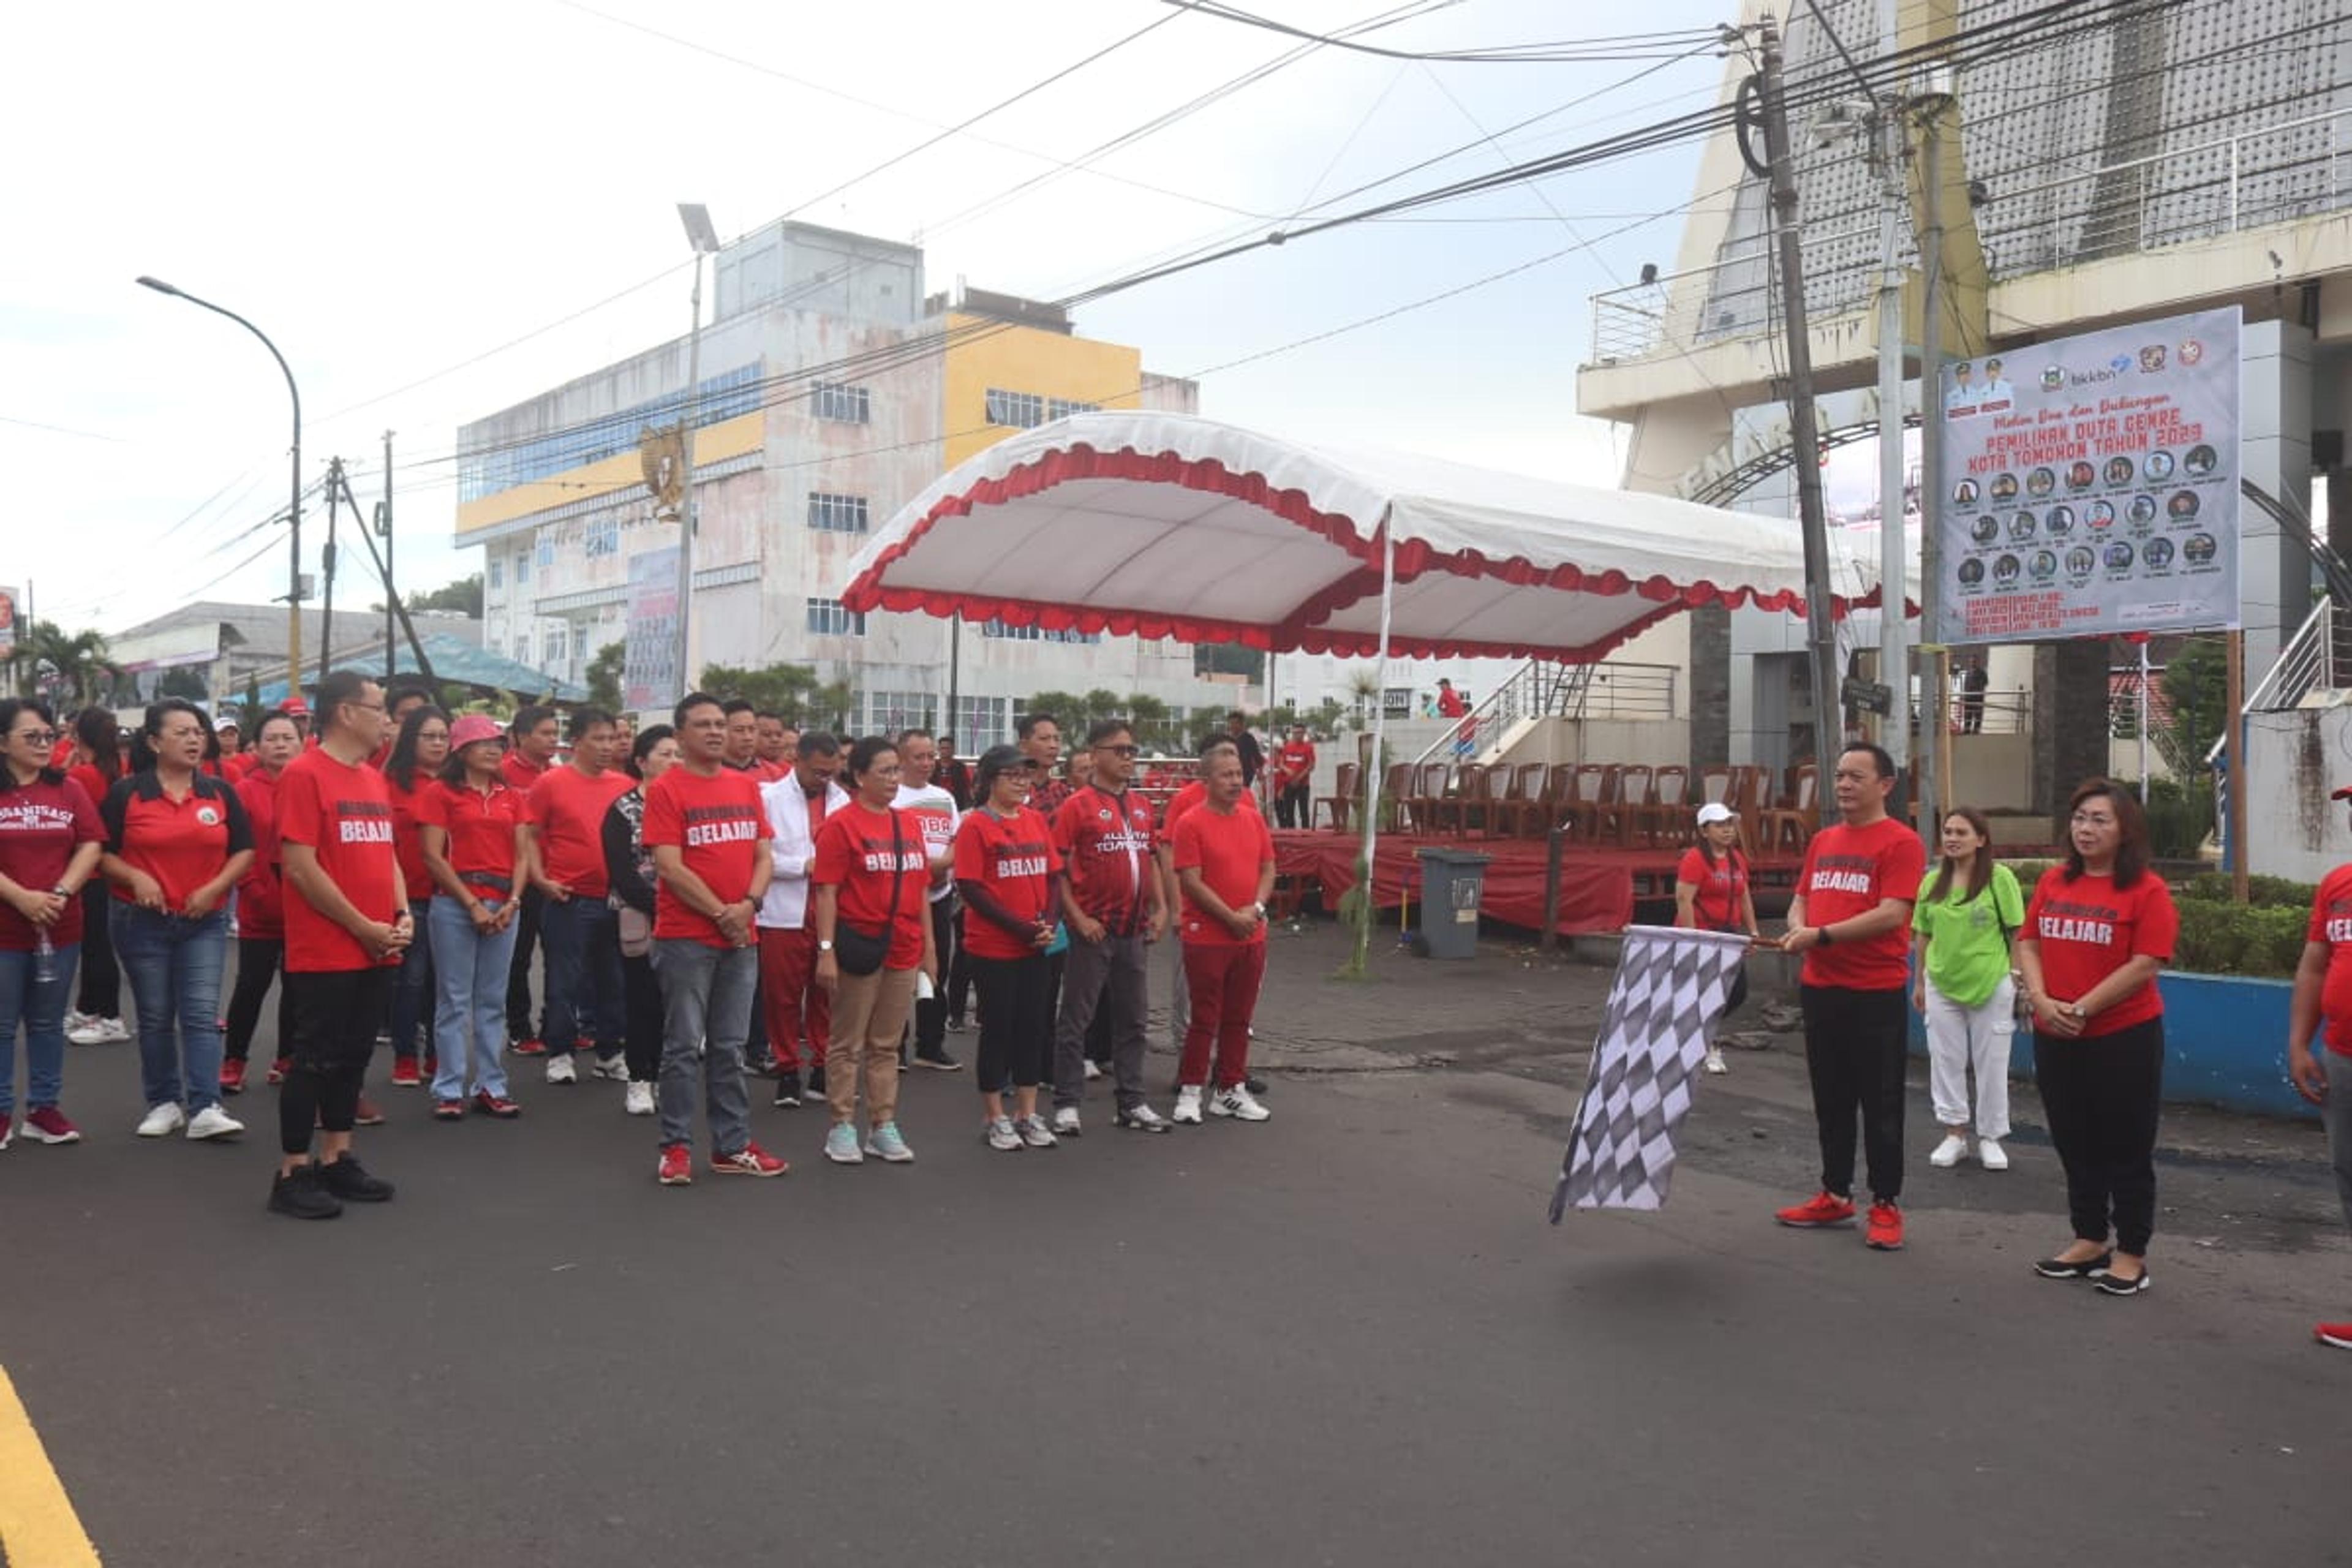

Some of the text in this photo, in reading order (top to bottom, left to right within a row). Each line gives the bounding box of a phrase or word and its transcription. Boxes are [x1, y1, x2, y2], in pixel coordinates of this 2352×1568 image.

[1969, 454, 2007, 473] KOTA
[2013, 442, 2086, 468] TOMOHON
[2094, 432, 2147, 456] TAHUN
[1986, 408, 2180, 454] PEMILIHAN DUTA GENRE
